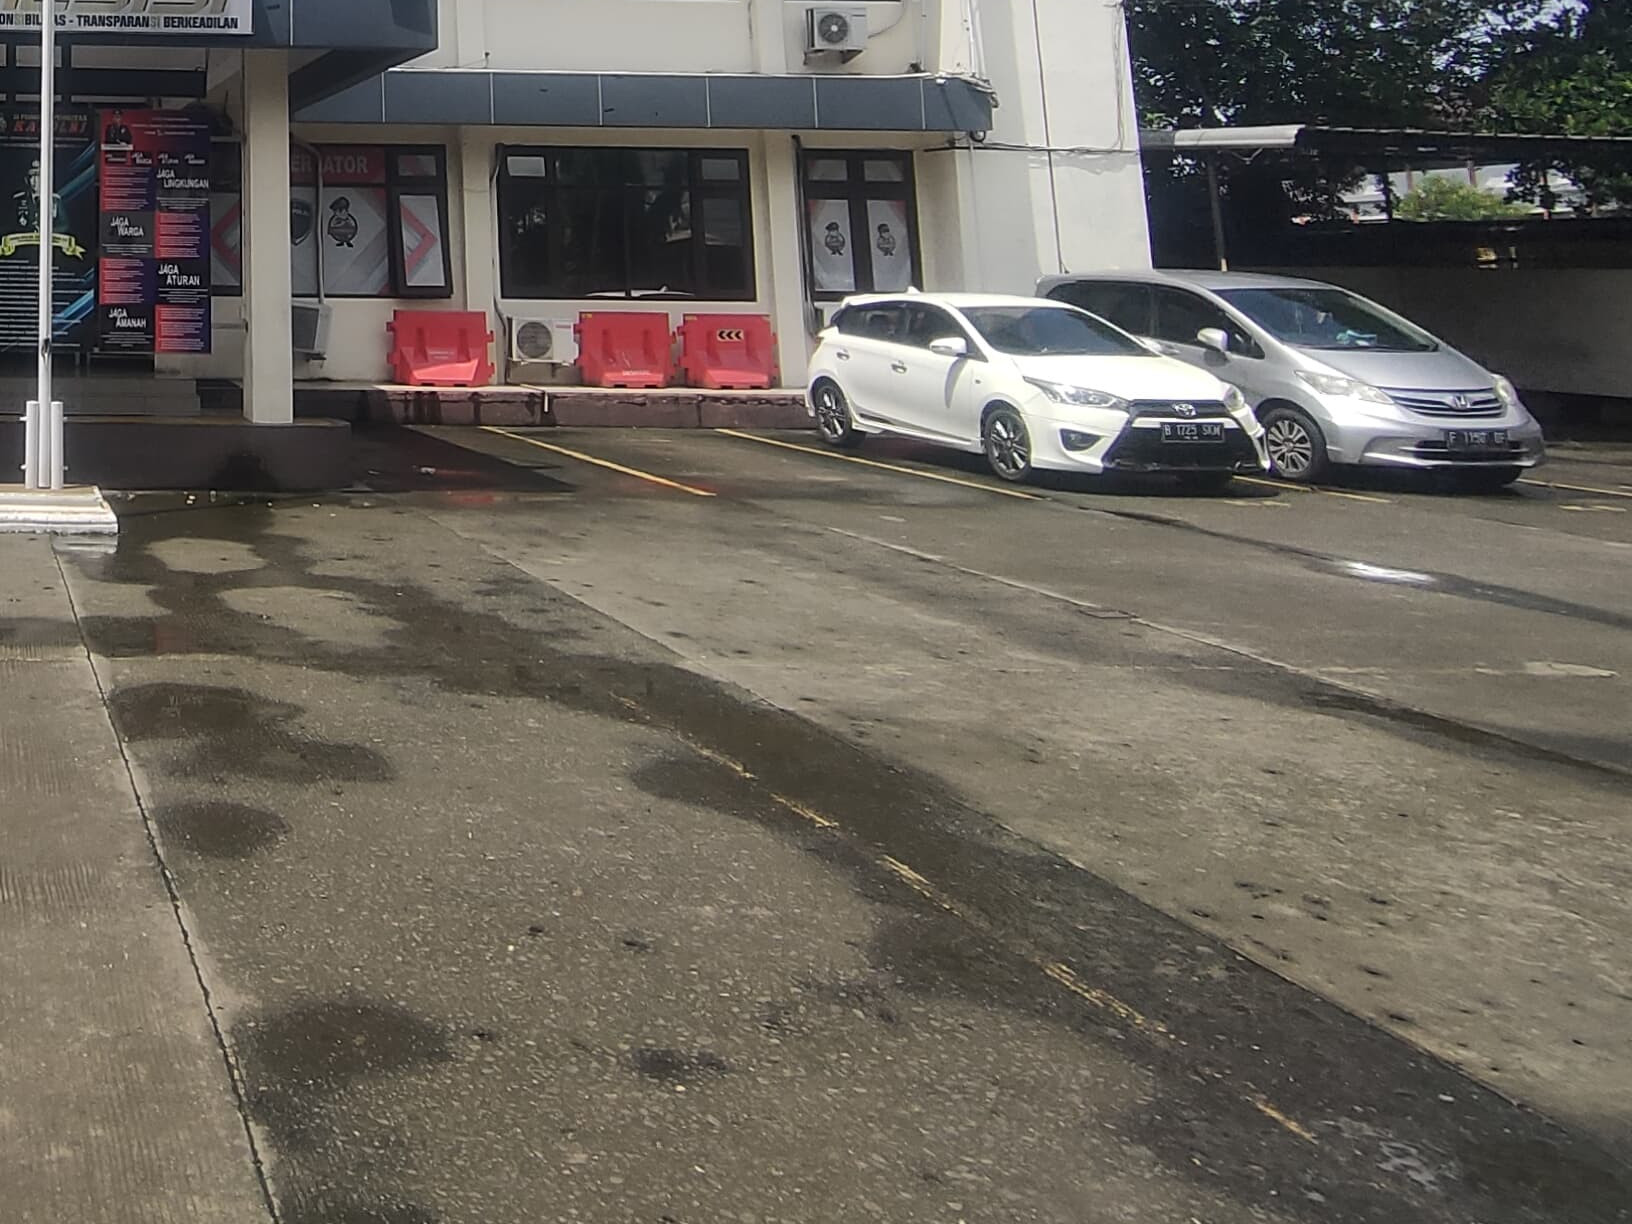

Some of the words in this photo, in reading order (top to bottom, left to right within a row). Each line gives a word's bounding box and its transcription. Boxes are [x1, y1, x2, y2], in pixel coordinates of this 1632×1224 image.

[163, 16, 238, 29] BERKEADILAN
[291, 155, 368, 174] ERATOR
[111, 217, 129, 226] JAGA
[118, 227, 144, 236] WARGA
[158, 264, 179, 275] JAGA
[166, 275, 200, 286] ATURAN
[108, 308, 128, 318] JAGA
[115, 318, 147, 328] AMANAH
[1164, 424, 1172, 436] B
